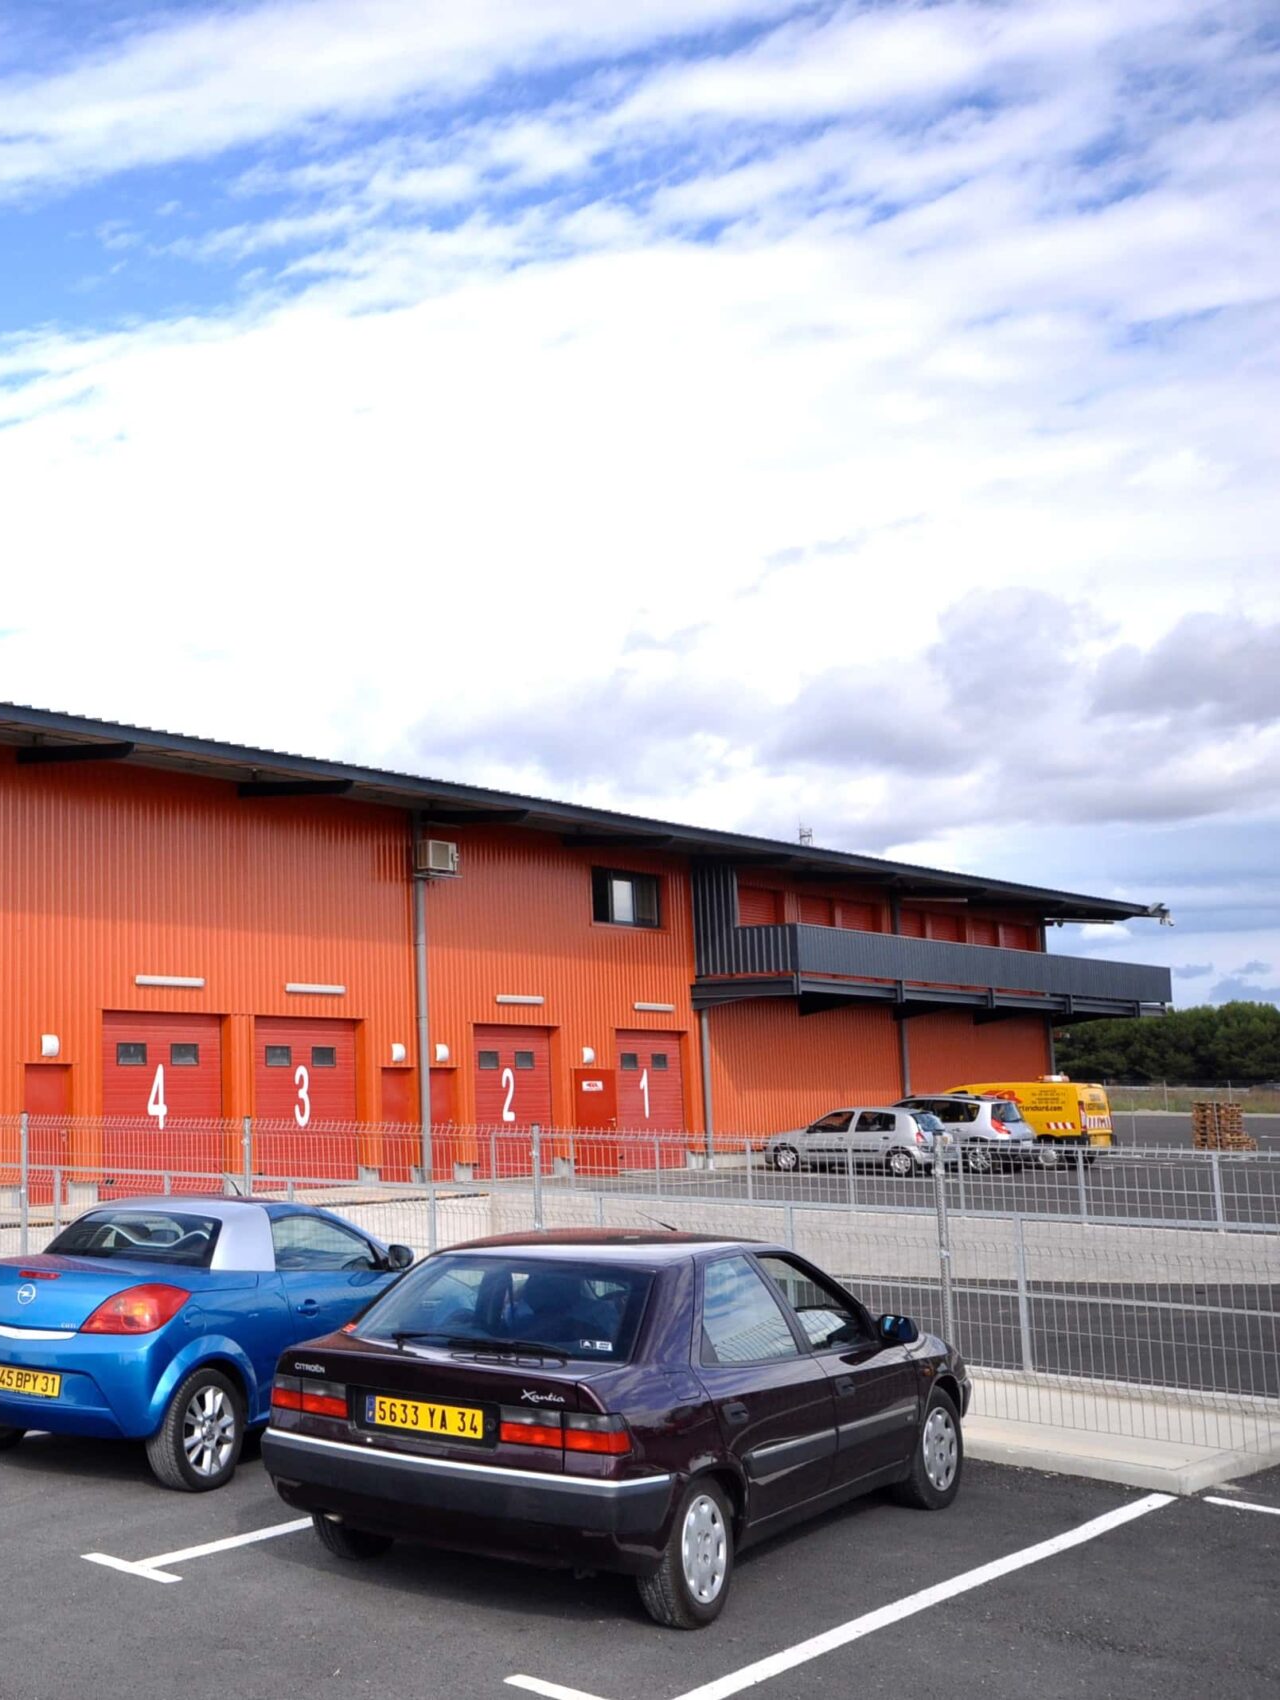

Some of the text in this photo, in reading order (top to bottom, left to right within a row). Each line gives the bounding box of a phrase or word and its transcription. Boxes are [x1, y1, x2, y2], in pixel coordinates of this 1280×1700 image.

[147, 1063, 167, 1130] 4
[294, 1065, 310, 1127] 3
[501, 1068, 515, 1122] 2
[639, 1068, 649, 1119] 1
[16, 1371, 39, 1391] BPY
[41, 1375, 56, 1394] 31
[521, 1389, 565, 1403] Xantia
[378, 1401, 478, 1434] 5633 YA 34
